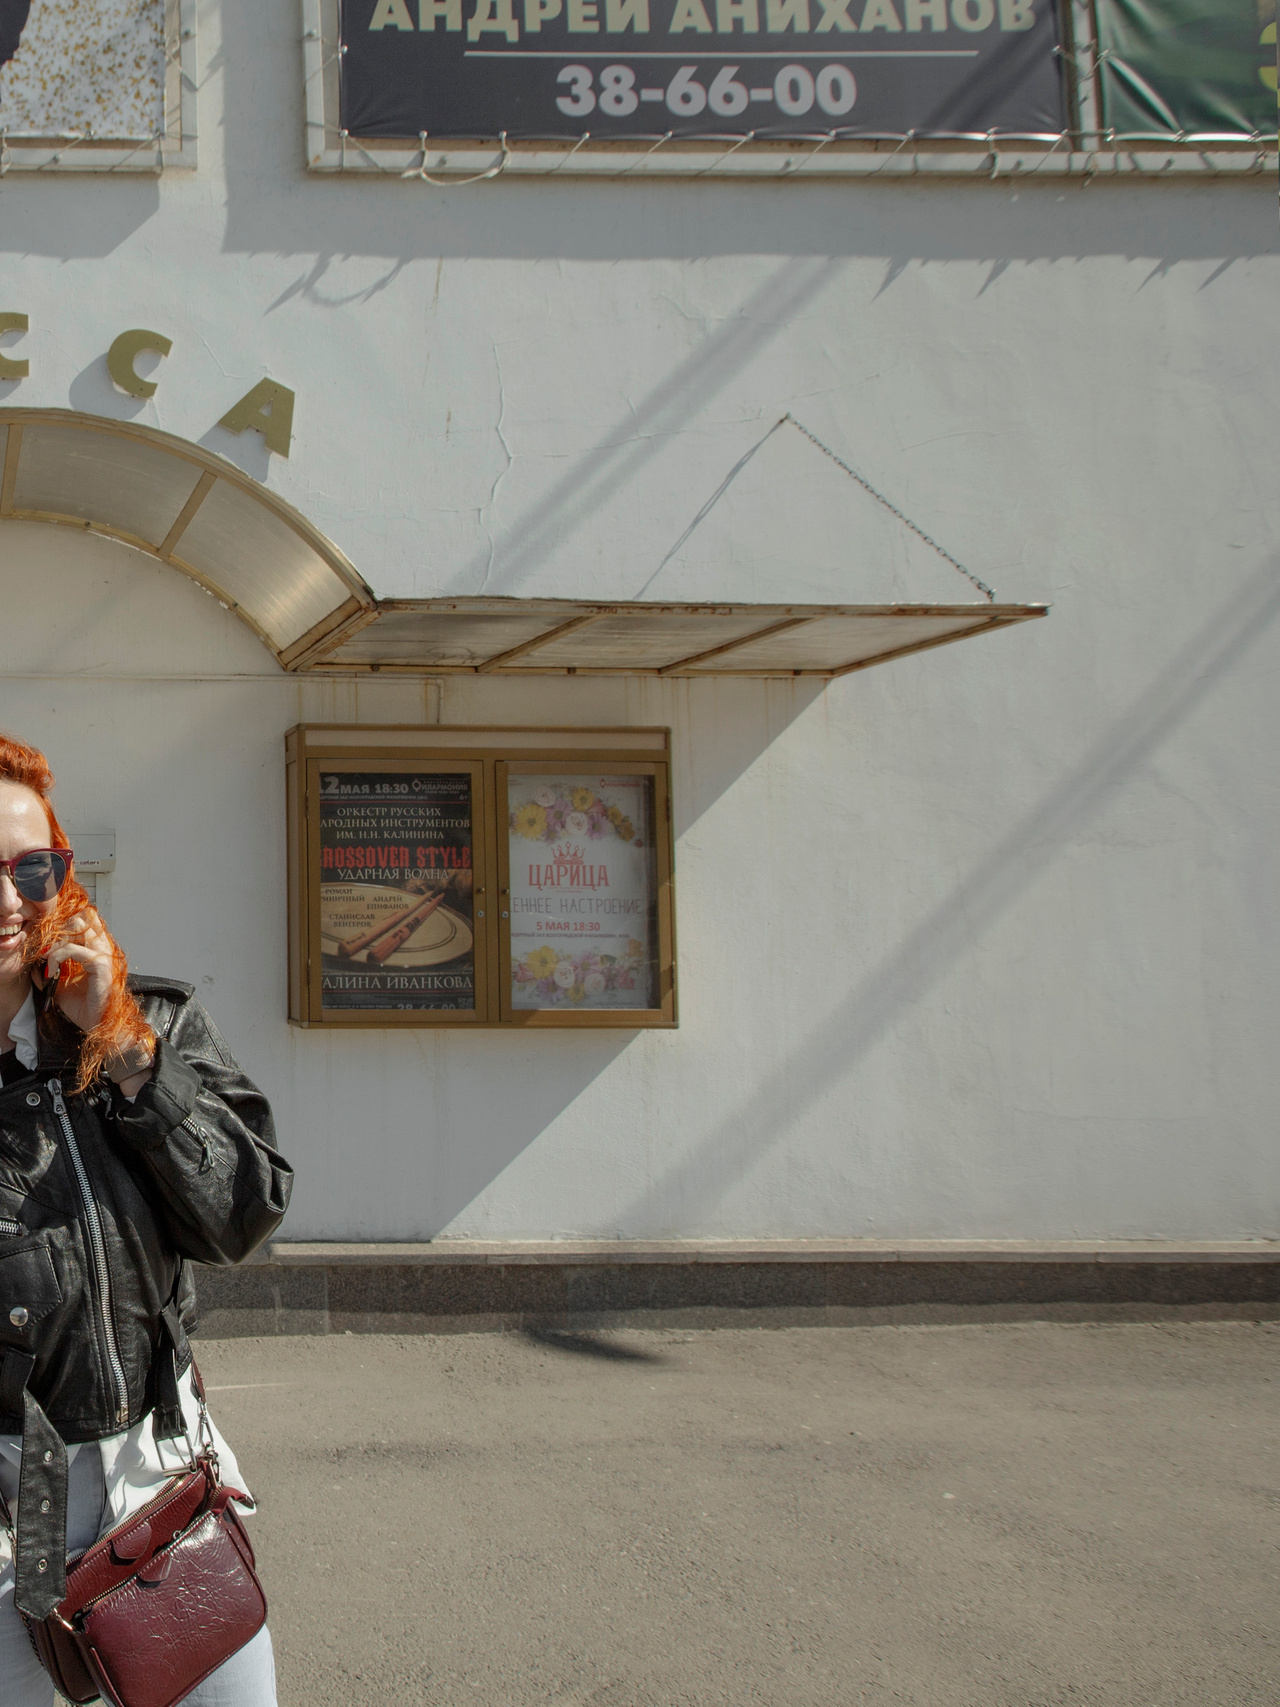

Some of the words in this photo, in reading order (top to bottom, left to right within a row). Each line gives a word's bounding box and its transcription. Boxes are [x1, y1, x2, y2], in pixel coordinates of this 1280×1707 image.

[668, 0, 1036, 34] АНИХАНОВ
[555, 64, 858, 117] 38-66-00
[340, 784, 370, 794] МАЯ
[374, 783, 409, 794] 18:30
[337, 807, 388, 817] ОРКЕСТР
[390, 808, 441, 817] РУССКИХ
[380, 818, 471, 828] ИНСТРУМЕНТОВ
[336, 830, 357, 839] ИМ.
[359, 830, 381, 839] Н.Н.
[383, 830, 444, 839] КАЛИНИНА
[320, 845, 411, 869] ROSSOVER
[416, 845, 471, 868] STYLE
[337, 868, 400, 880] УДАРНАЯ
[404, 868, 449, 880] ВОЛНА
[528, 864, 610, 891] ЦАРИЦА
[372, 894, 403, 902] АНДРЕЙ
[510, 897, 553, 914] ЕННЕЕ
[560, 898, 642, 915] НАСТРОЕНИЕ
[536, 921, 543, 931] 5
[545, 921, 570, 931] МАЯ
[573, 921, 601, 932] 18:30
[321, 976, 382, 989] АЛИНА
[386, 976, 472, 989] ИВАНКОВА
